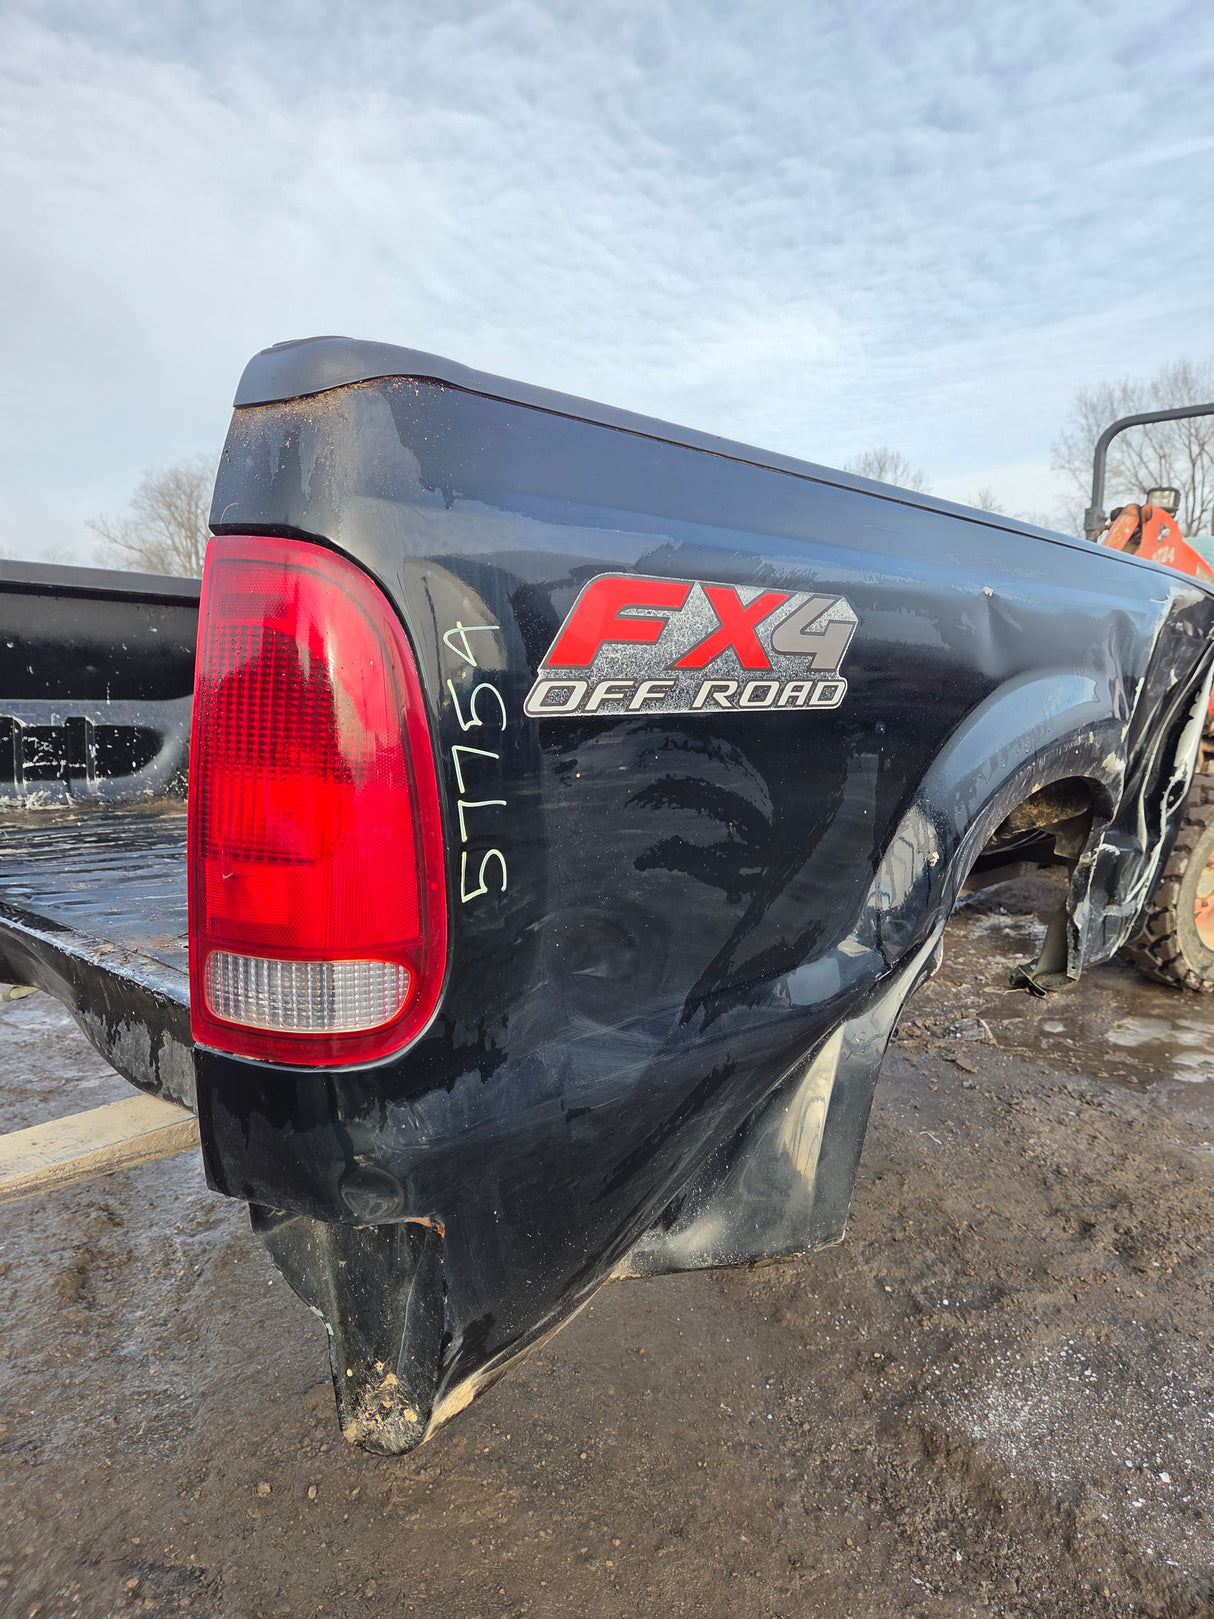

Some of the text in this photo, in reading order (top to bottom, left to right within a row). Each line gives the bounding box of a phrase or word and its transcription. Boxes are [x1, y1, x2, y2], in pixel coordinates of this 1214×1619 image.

[542, 575, 857, 671] FX4
[527, 680, 847, 713] OFF ROAD
